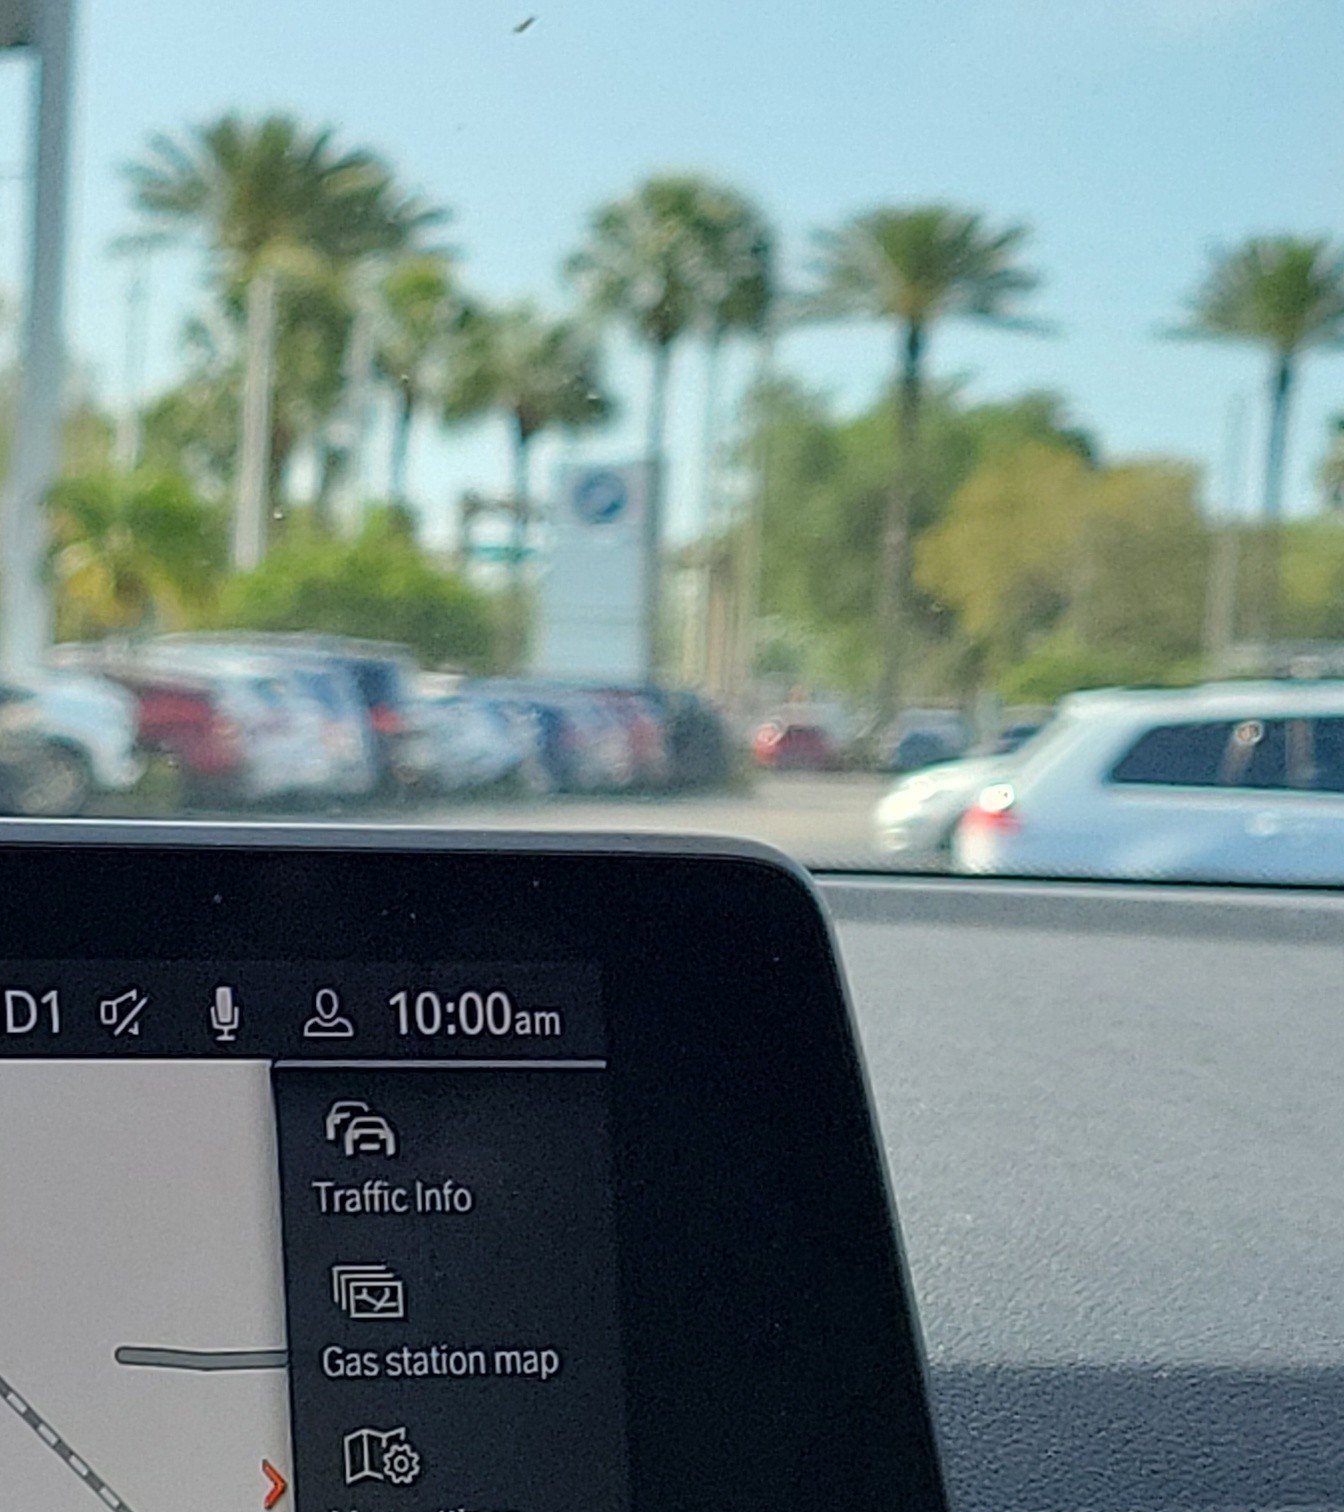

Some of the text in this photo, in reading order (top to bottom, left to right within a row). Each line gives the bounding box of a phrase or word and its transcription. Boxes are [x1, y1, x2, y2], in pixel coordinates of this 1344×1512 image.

[313, 1180, 473, 1214] Traffic Info
[322, 1345, 559, 1379] Gas station map
